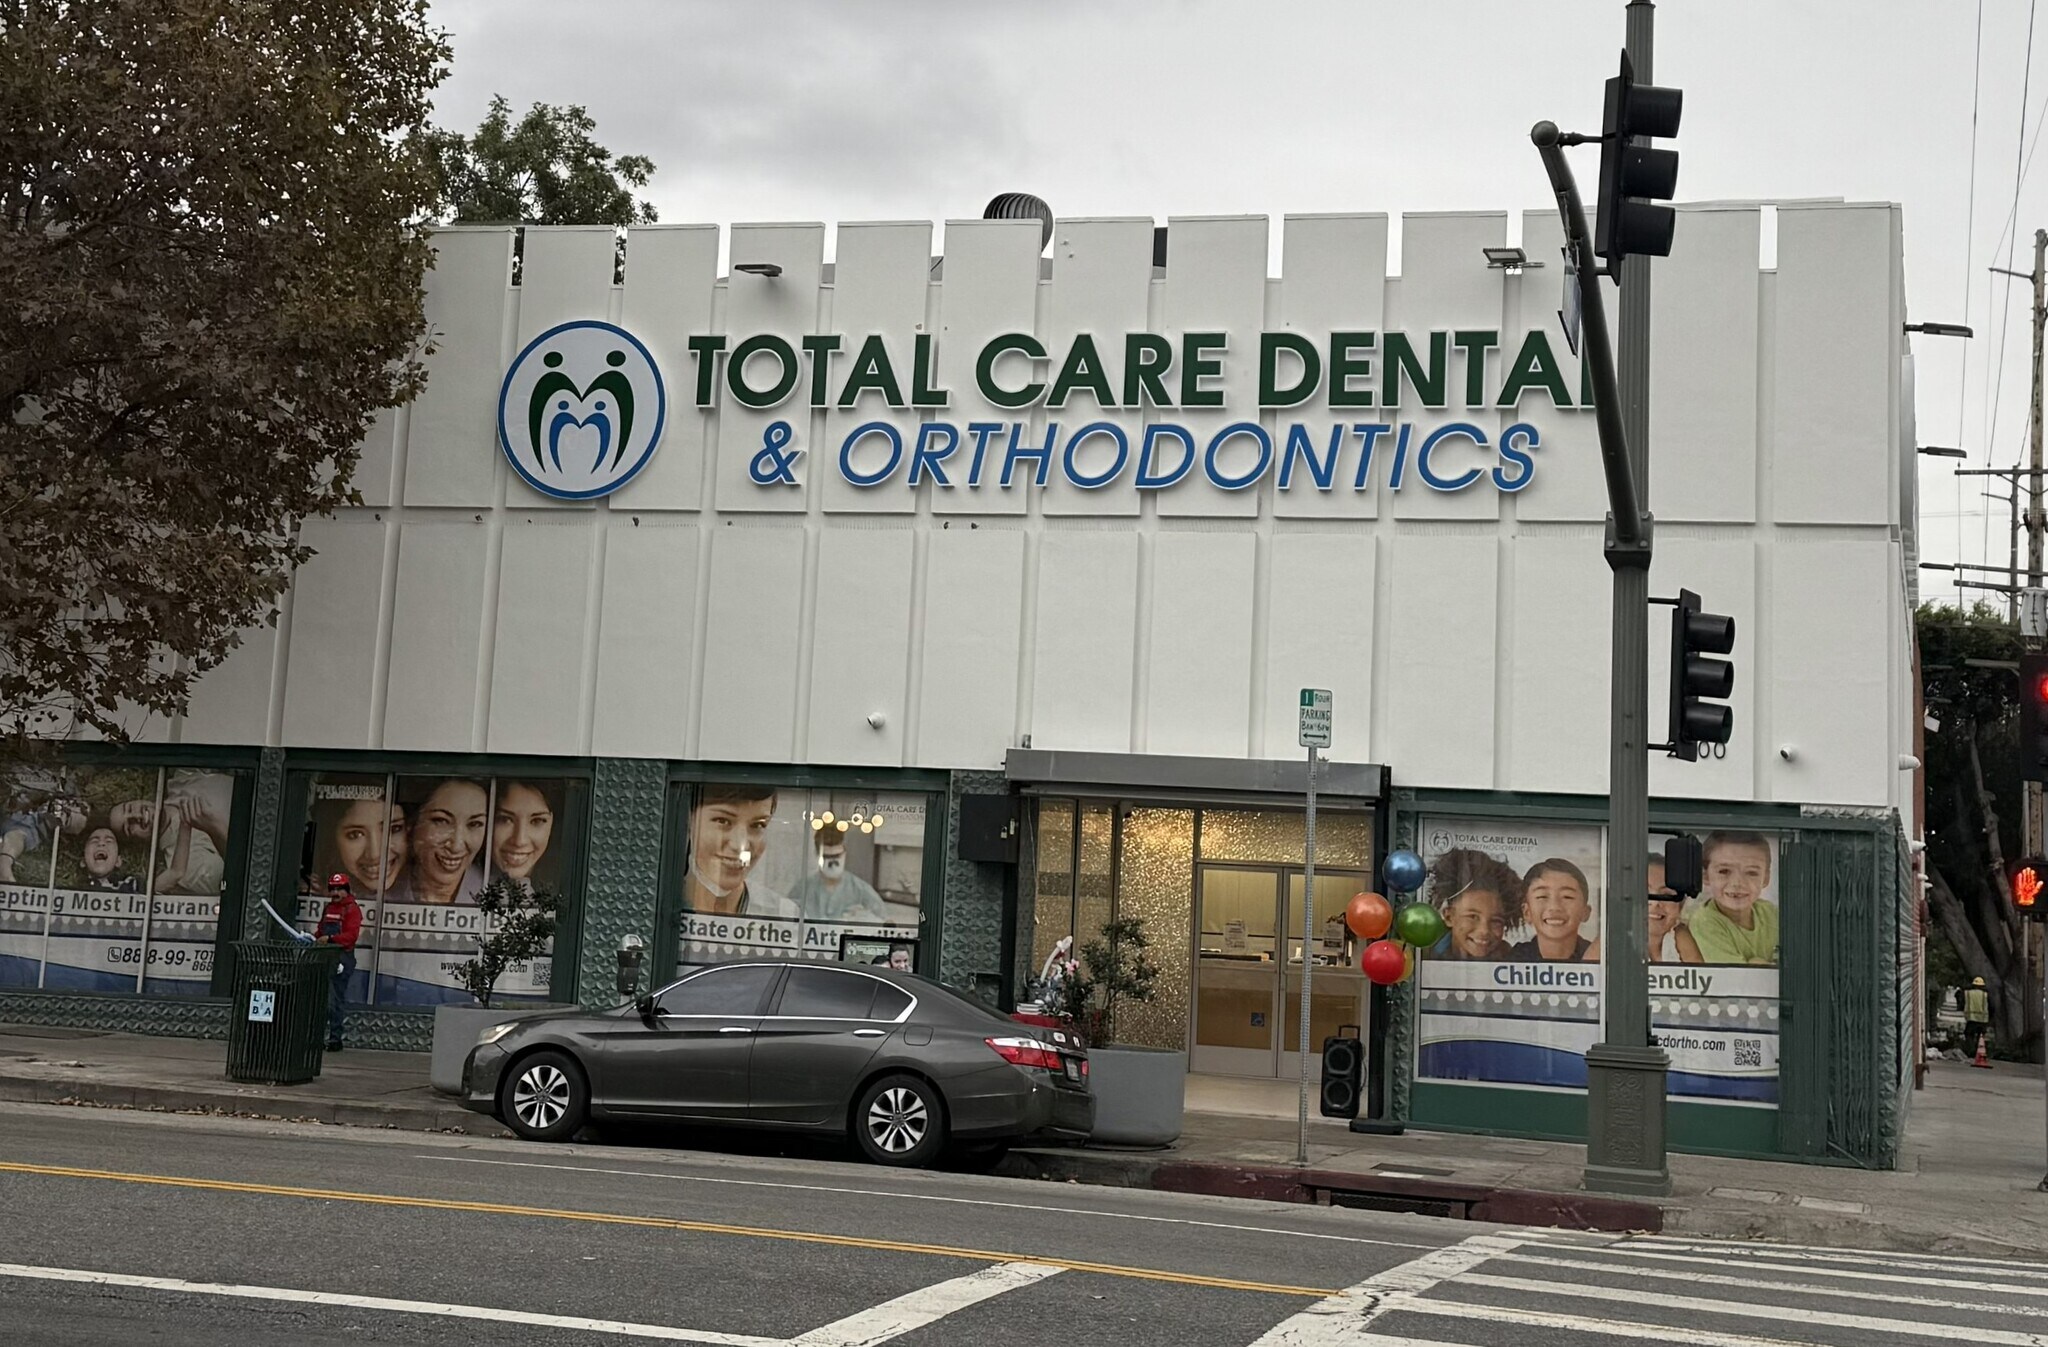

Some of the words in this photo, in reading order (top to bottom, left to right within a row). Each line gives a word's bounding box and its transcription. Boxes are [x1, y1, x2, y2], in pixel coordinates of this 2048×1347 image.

[687, 332, 950, 408] TOTAL
[974, 331, 1226, 409] CARE
[748, 420, 802, 486] &
[837, 420, 1542, 493] ORTHODONTICS
[1301, 708, 1330, 721] PARKING
[1455, 834, 1479, 843] TOTAL
[1481, 835, 1505, 844] CARE
[1507, 836, 1538, 846] DENTAL
[71, 892, 121, 912] Most
[359, 902, 437, 927] onsult
[444, 909, 479, 929] For
[679, 916, 728, 939] State
[733, 923, 754, 940] of
[759, 923, 792, 943] the
[804, 927, 837, 947] Art
[1493, 965, 1594, 987] Children
[1647, 969, 1713, 995] endly
